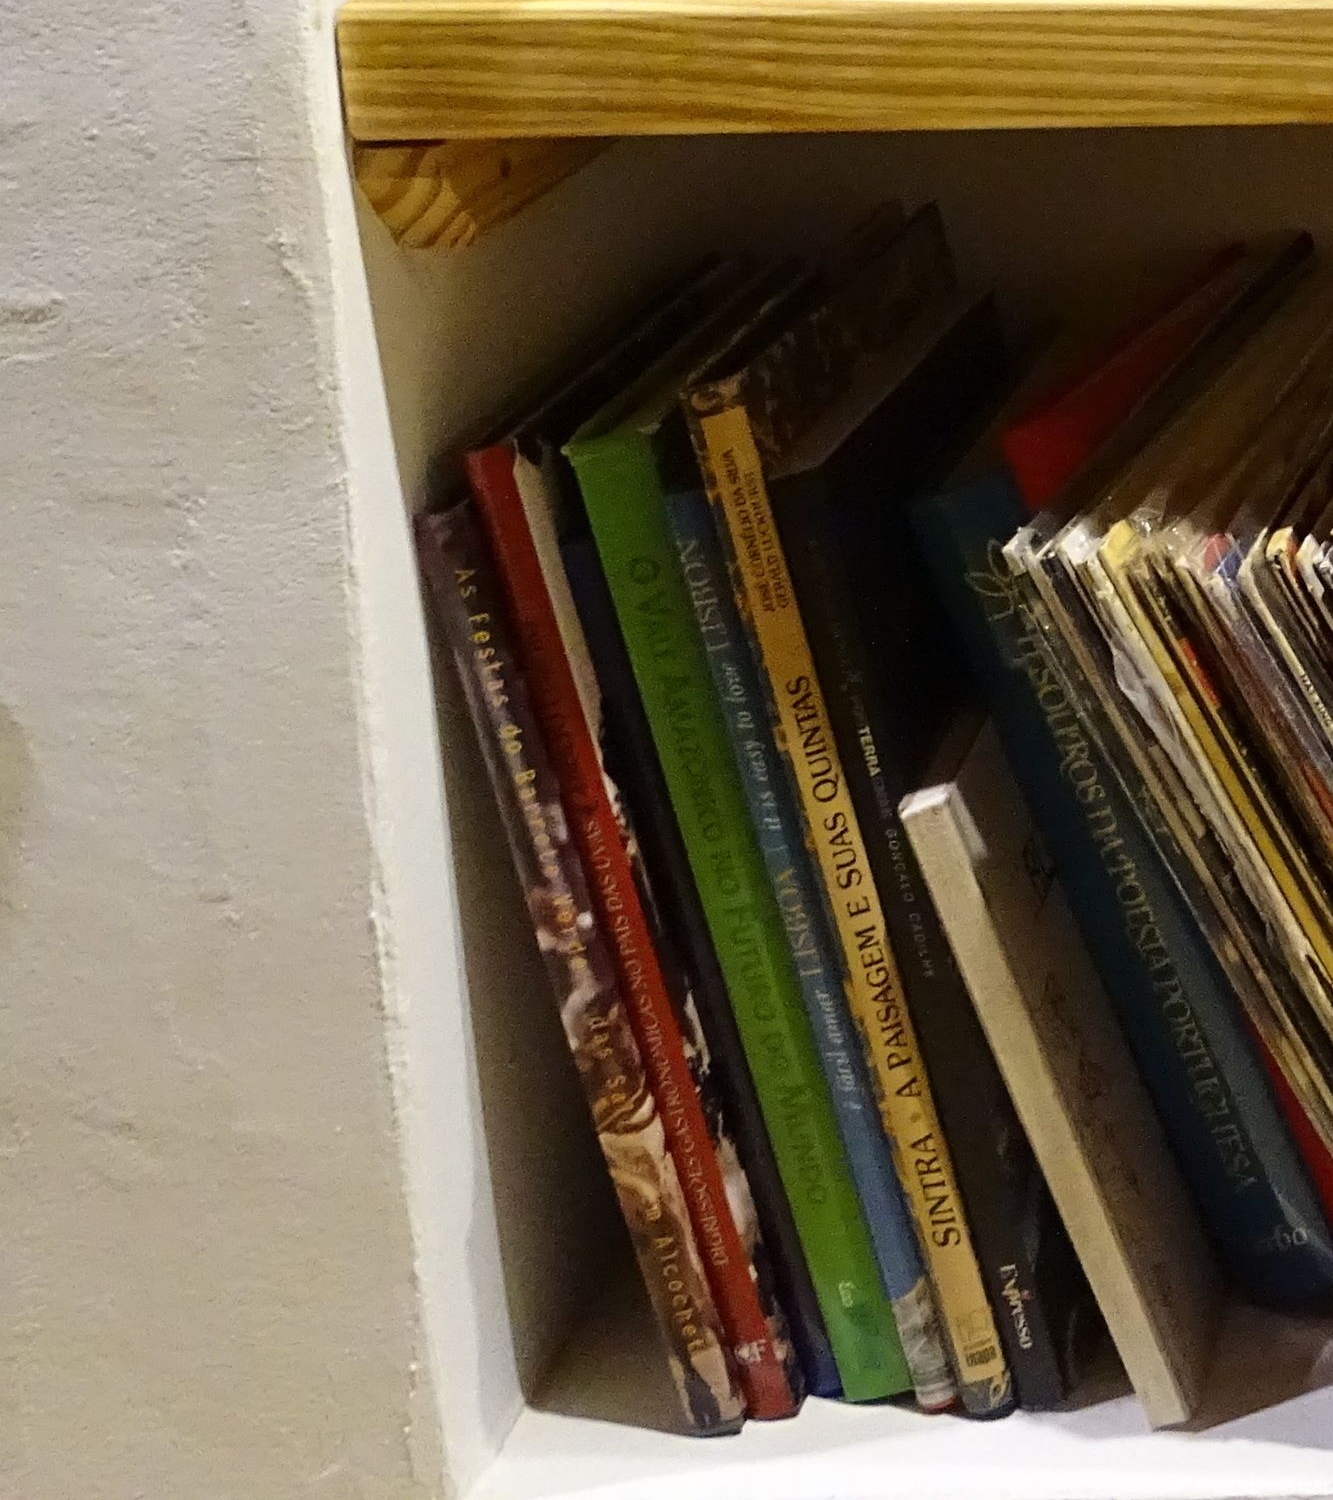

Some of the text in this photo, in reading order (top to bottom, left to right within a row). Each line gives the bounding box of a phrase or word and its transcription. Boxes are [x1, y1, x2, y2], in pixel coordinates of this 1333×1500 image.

[717, 447, 744, 484] SILVA
[729, 486, 747, 507] DA
[451, 563, 483, 599] As
[678, 536, 729, 654] LISBON
[752, 579, 778, 614] JOSÉ
[764, 555, 793, 608] GERALD
[855, 724, 883, 778] TERRA
[773, 866, 823, 979] LISBOA
[1012, 630, 1258, 1190] TESOUROS DA POESIA PORTUGUESA
[785, 673, 962, 1248] SINTRA A PAISAGEM E SUAS QUINTAS
[811, 986, 846, 1046] amar
[1000, 1262, 1033, 1349] Expresso
